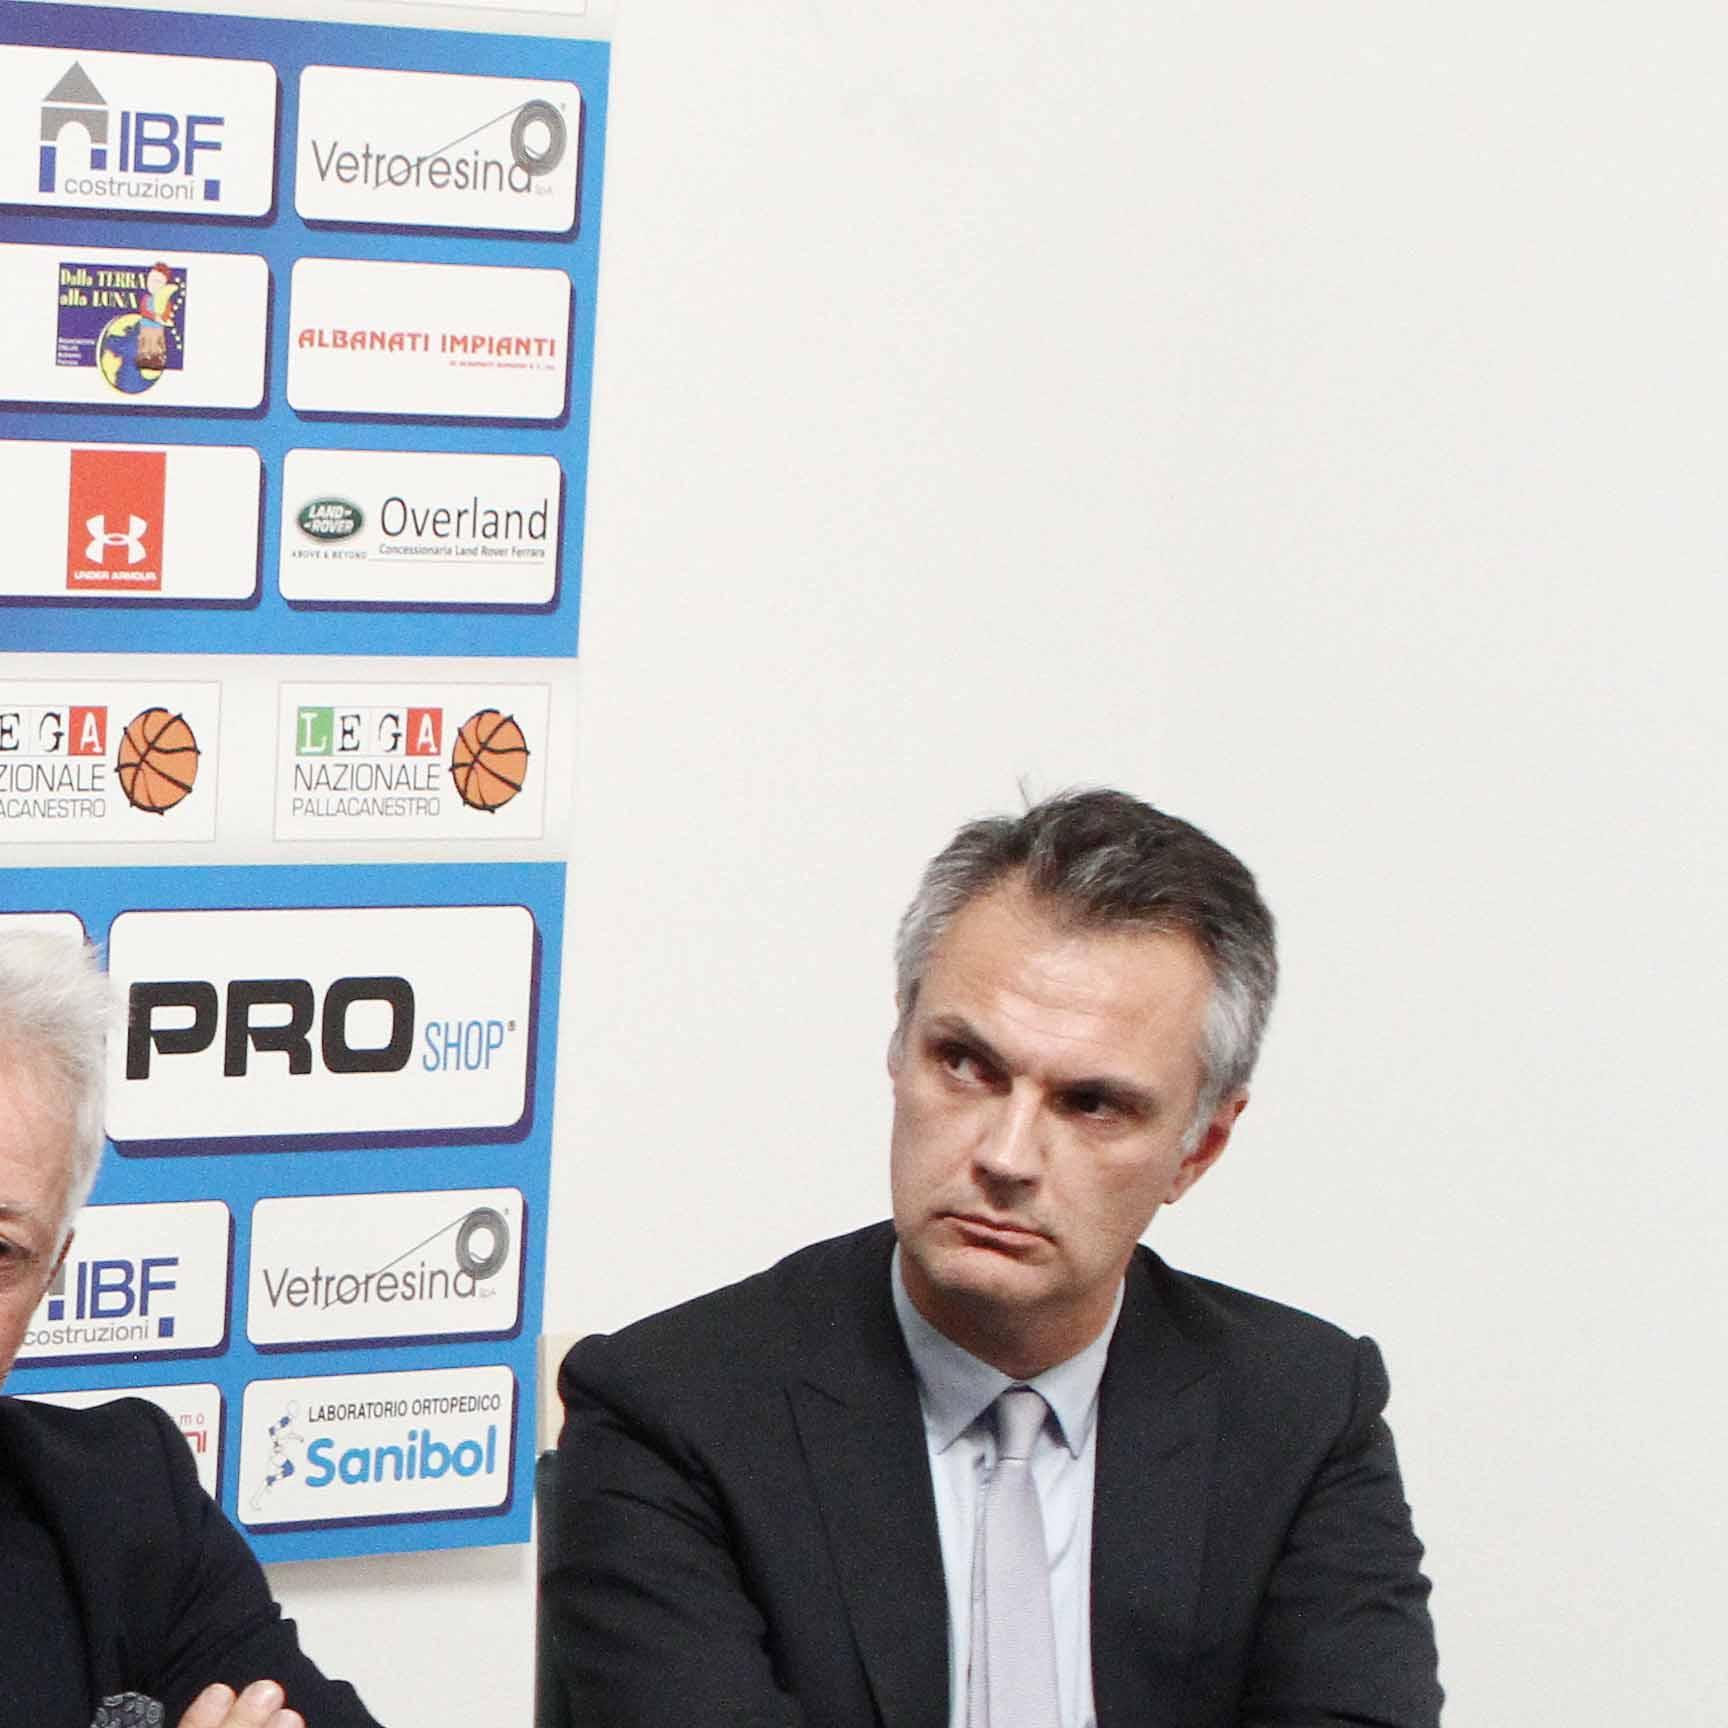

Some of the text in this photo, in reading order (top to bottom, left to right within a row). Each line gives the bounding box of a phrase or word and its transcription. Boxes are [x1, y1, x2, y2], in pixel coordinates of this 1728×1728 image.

[120, 112, 224, 176] IBF
[64, 174, 193, 200] costruzioni
[312, 140, 531, 193] Vetroresina
[298, 328, 556, 357] ALBANATI IMPIANTI
[381, 496, 547, 540] Overland
[295, 707, 442, 756] LEGA
[293, 762, 440, 792] NAZIONALE
[292, 796, 440, 817] PALLACANESTRO
[125, 976, 415, 1080] PRO
[75, 1257, 178, 1321] IBF
[262, 1267, 478, 1309] Vetroresina
[308, 1394, 501, 1423] LABORATORIO ORTOPEDICO
[305, 1424, 496, 1489] Sanibol
